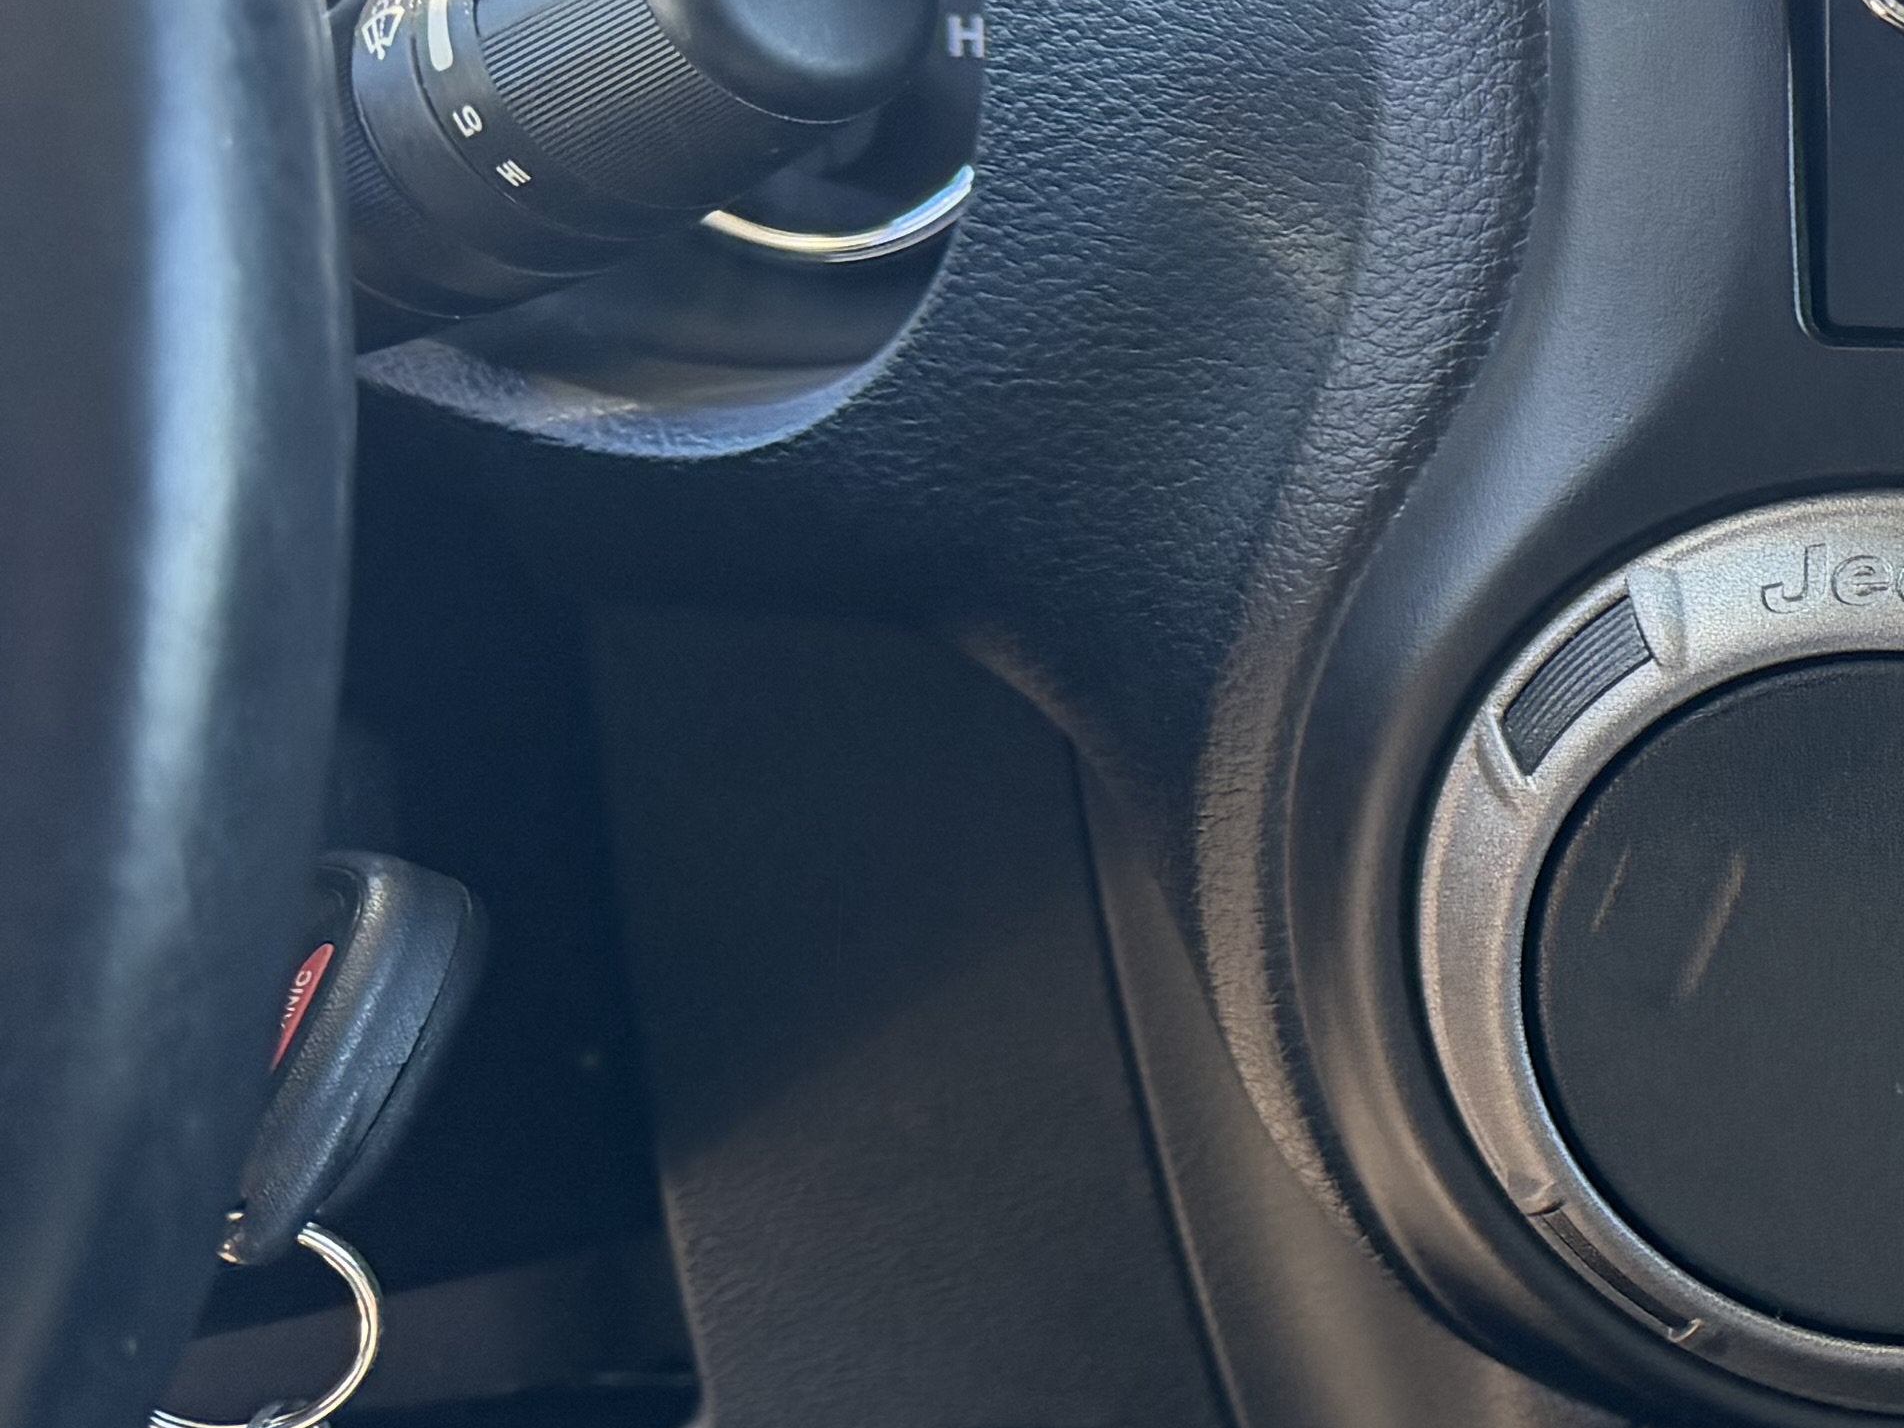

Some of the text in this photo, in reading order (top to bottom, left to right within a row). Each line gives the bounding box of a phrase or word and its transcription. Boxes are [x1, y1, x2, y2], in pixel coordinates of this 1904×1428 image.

[946, 12, 985, 59] H
[453, 105, 482, 137] LO
[496, 160, 531, 186] HI
